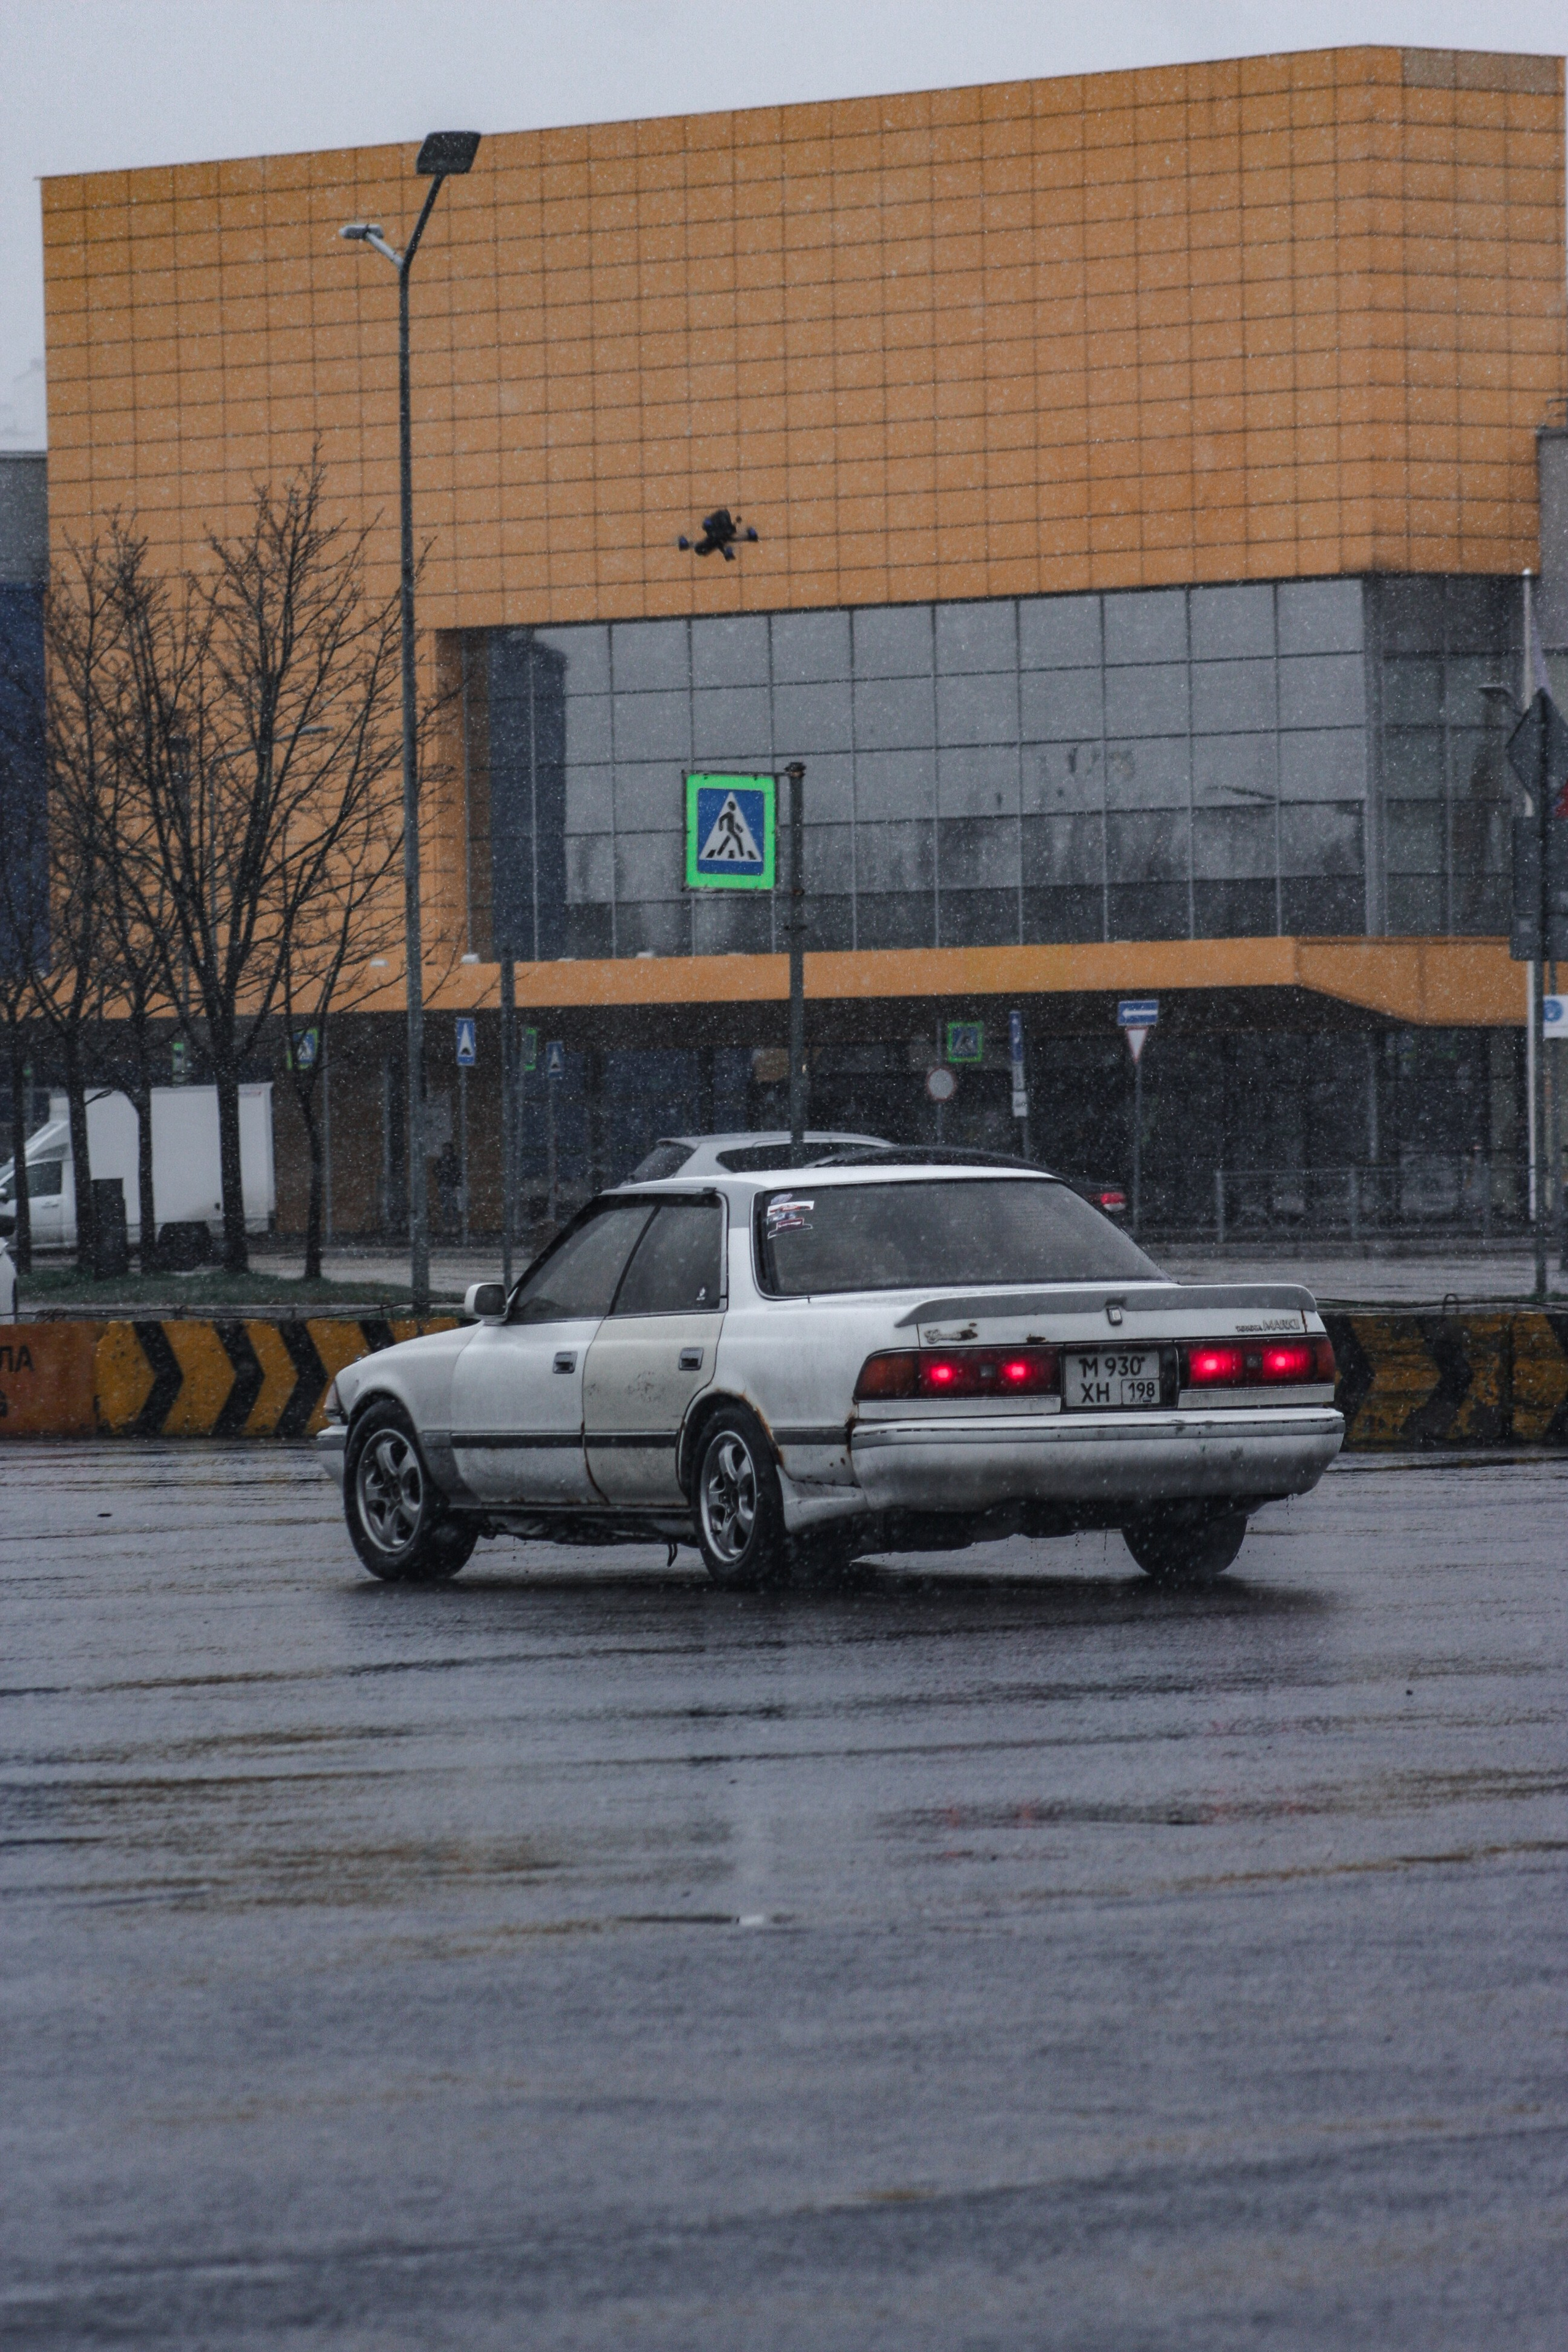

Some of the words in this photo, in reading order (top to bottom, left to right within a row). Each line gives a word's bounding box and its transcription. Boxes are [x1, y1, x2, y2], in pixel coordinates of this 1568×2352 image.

[1080, 1357, 1098, 1378] М
[1104, 1356, 1142, 1376] 930
[1081, 1382, 1110, 1403] ХН
[1128, 1382, 1155, 1398] 198
